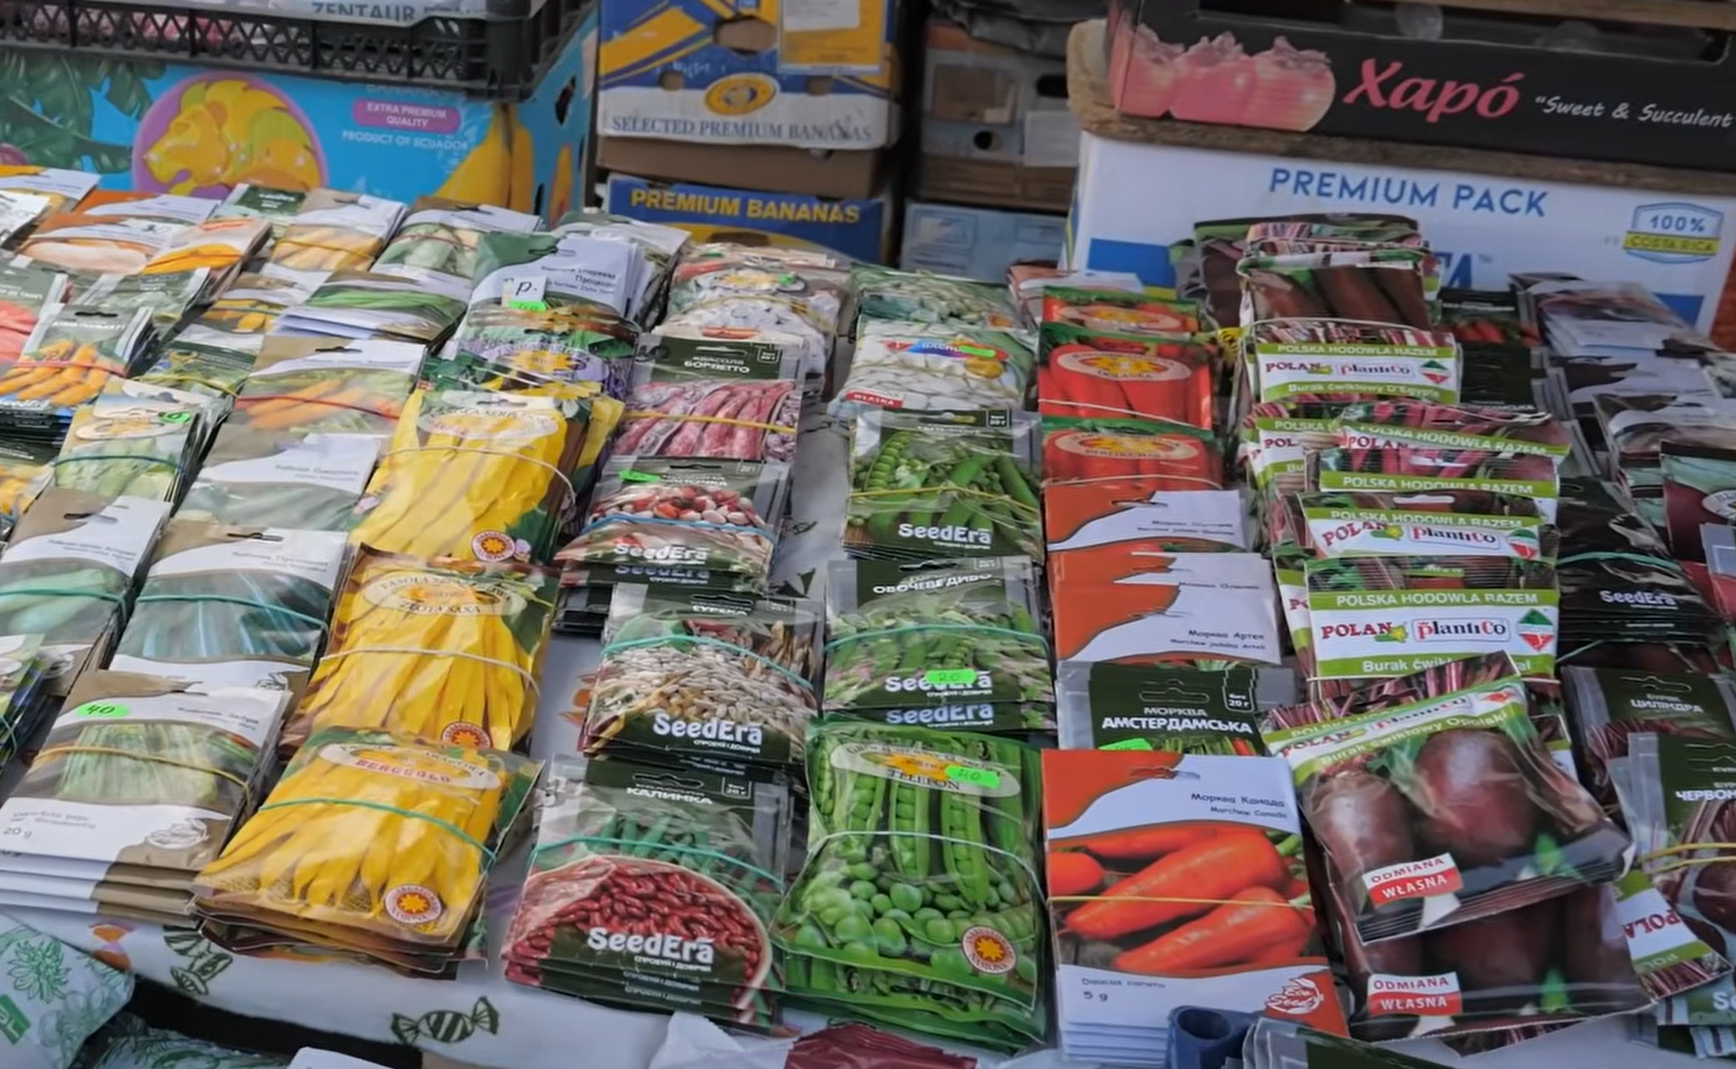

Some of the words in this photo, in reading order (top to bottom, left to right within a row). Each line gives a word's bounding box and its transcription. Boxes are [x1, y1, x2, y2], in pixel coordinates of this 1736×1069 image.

[366, 102, 399, 114] EXTRA
[401, 104, 447, 118] PREMIUM
[1611, 102, 1630, 120] &
[1638, 104, 1732, 129] Succulent
[386, 115, 428, 127] QUALITY
[612, 116, 695, 135] SELECTED
[699, 118, 783, 140] PREMIUM
[788, 122, 872, 142] BANANAS
[342, 130, 393, 144] PRODUCT
[395, 136, 411, 147] OF
[1269, 168, 1440, 208] PREMIUM
[1453, 183, 1550, 217] PACK
[630, 189, 742, 217] PREMIUM
[746, 200, 861, 223] BANANAS
[1650, 215, 1705, 232] 100%
[1277, 344, 1326, 354] POLSKA
[1329, 345, 1391, 355] HODOWLA
[1395, 346, 1438, 356] RAZEM
[1265, 361, 1321, 373] POLAN
[1288, 383, 1325, 393] Burak
[1275, 419, 1325, 432] POLSKA
[1416, 431, 1491, 449] HODOWLA
[1495, 441, 1548, 455] RAZEM
[1342, 475, 1398, 489] POLSKA
[1401, 476, 1476, 490] HODOWLA
[1480, 482, 1534, 495] RAZEM
[1331, 510, 1388, 522] POLSKA
[1392, 513, 1467, 526] HODOWLA
[1469, 517, 1525, 529] RAZEM
[897, 522, 993, 545] SeedEra
[1322, 521, 1388, 547] POLAN
[614, 543, 711, 561] SeedEra
[1336, 594, 1397, 607] POLSKA
[1401, 593, 1480, 606] HODOWLA
[1484, 592, 1538, 605] RAZEM
[1321, 621, 1393, 640] POLAN
[1362, 659, 1408, 673] Burak
[1144, 706, 1208, 717] МОРКВА
[1446, 711, 1508, 727] Opolski
[652, 711, 763, 746] SeedEra
[1102, 717, 1253, 734] АМСТЕРДАМСЬКА
[626, 787, 713, 805] КАЛИНКА
[1190, 792, 1237, 805] Морква
[1370, 855, 1445, 885] ODMIANA
[1381, 872, 1448, 901] WŁASNA
[587, 926, 715, 964] SeedEra
[1372, 974, 1450, 992] ODMIANA
[1083, 990, 1093, 999] 5
[1099, 993, 1108, 1002] g
[1380, 994, 1448, 1011] WŁASNA
